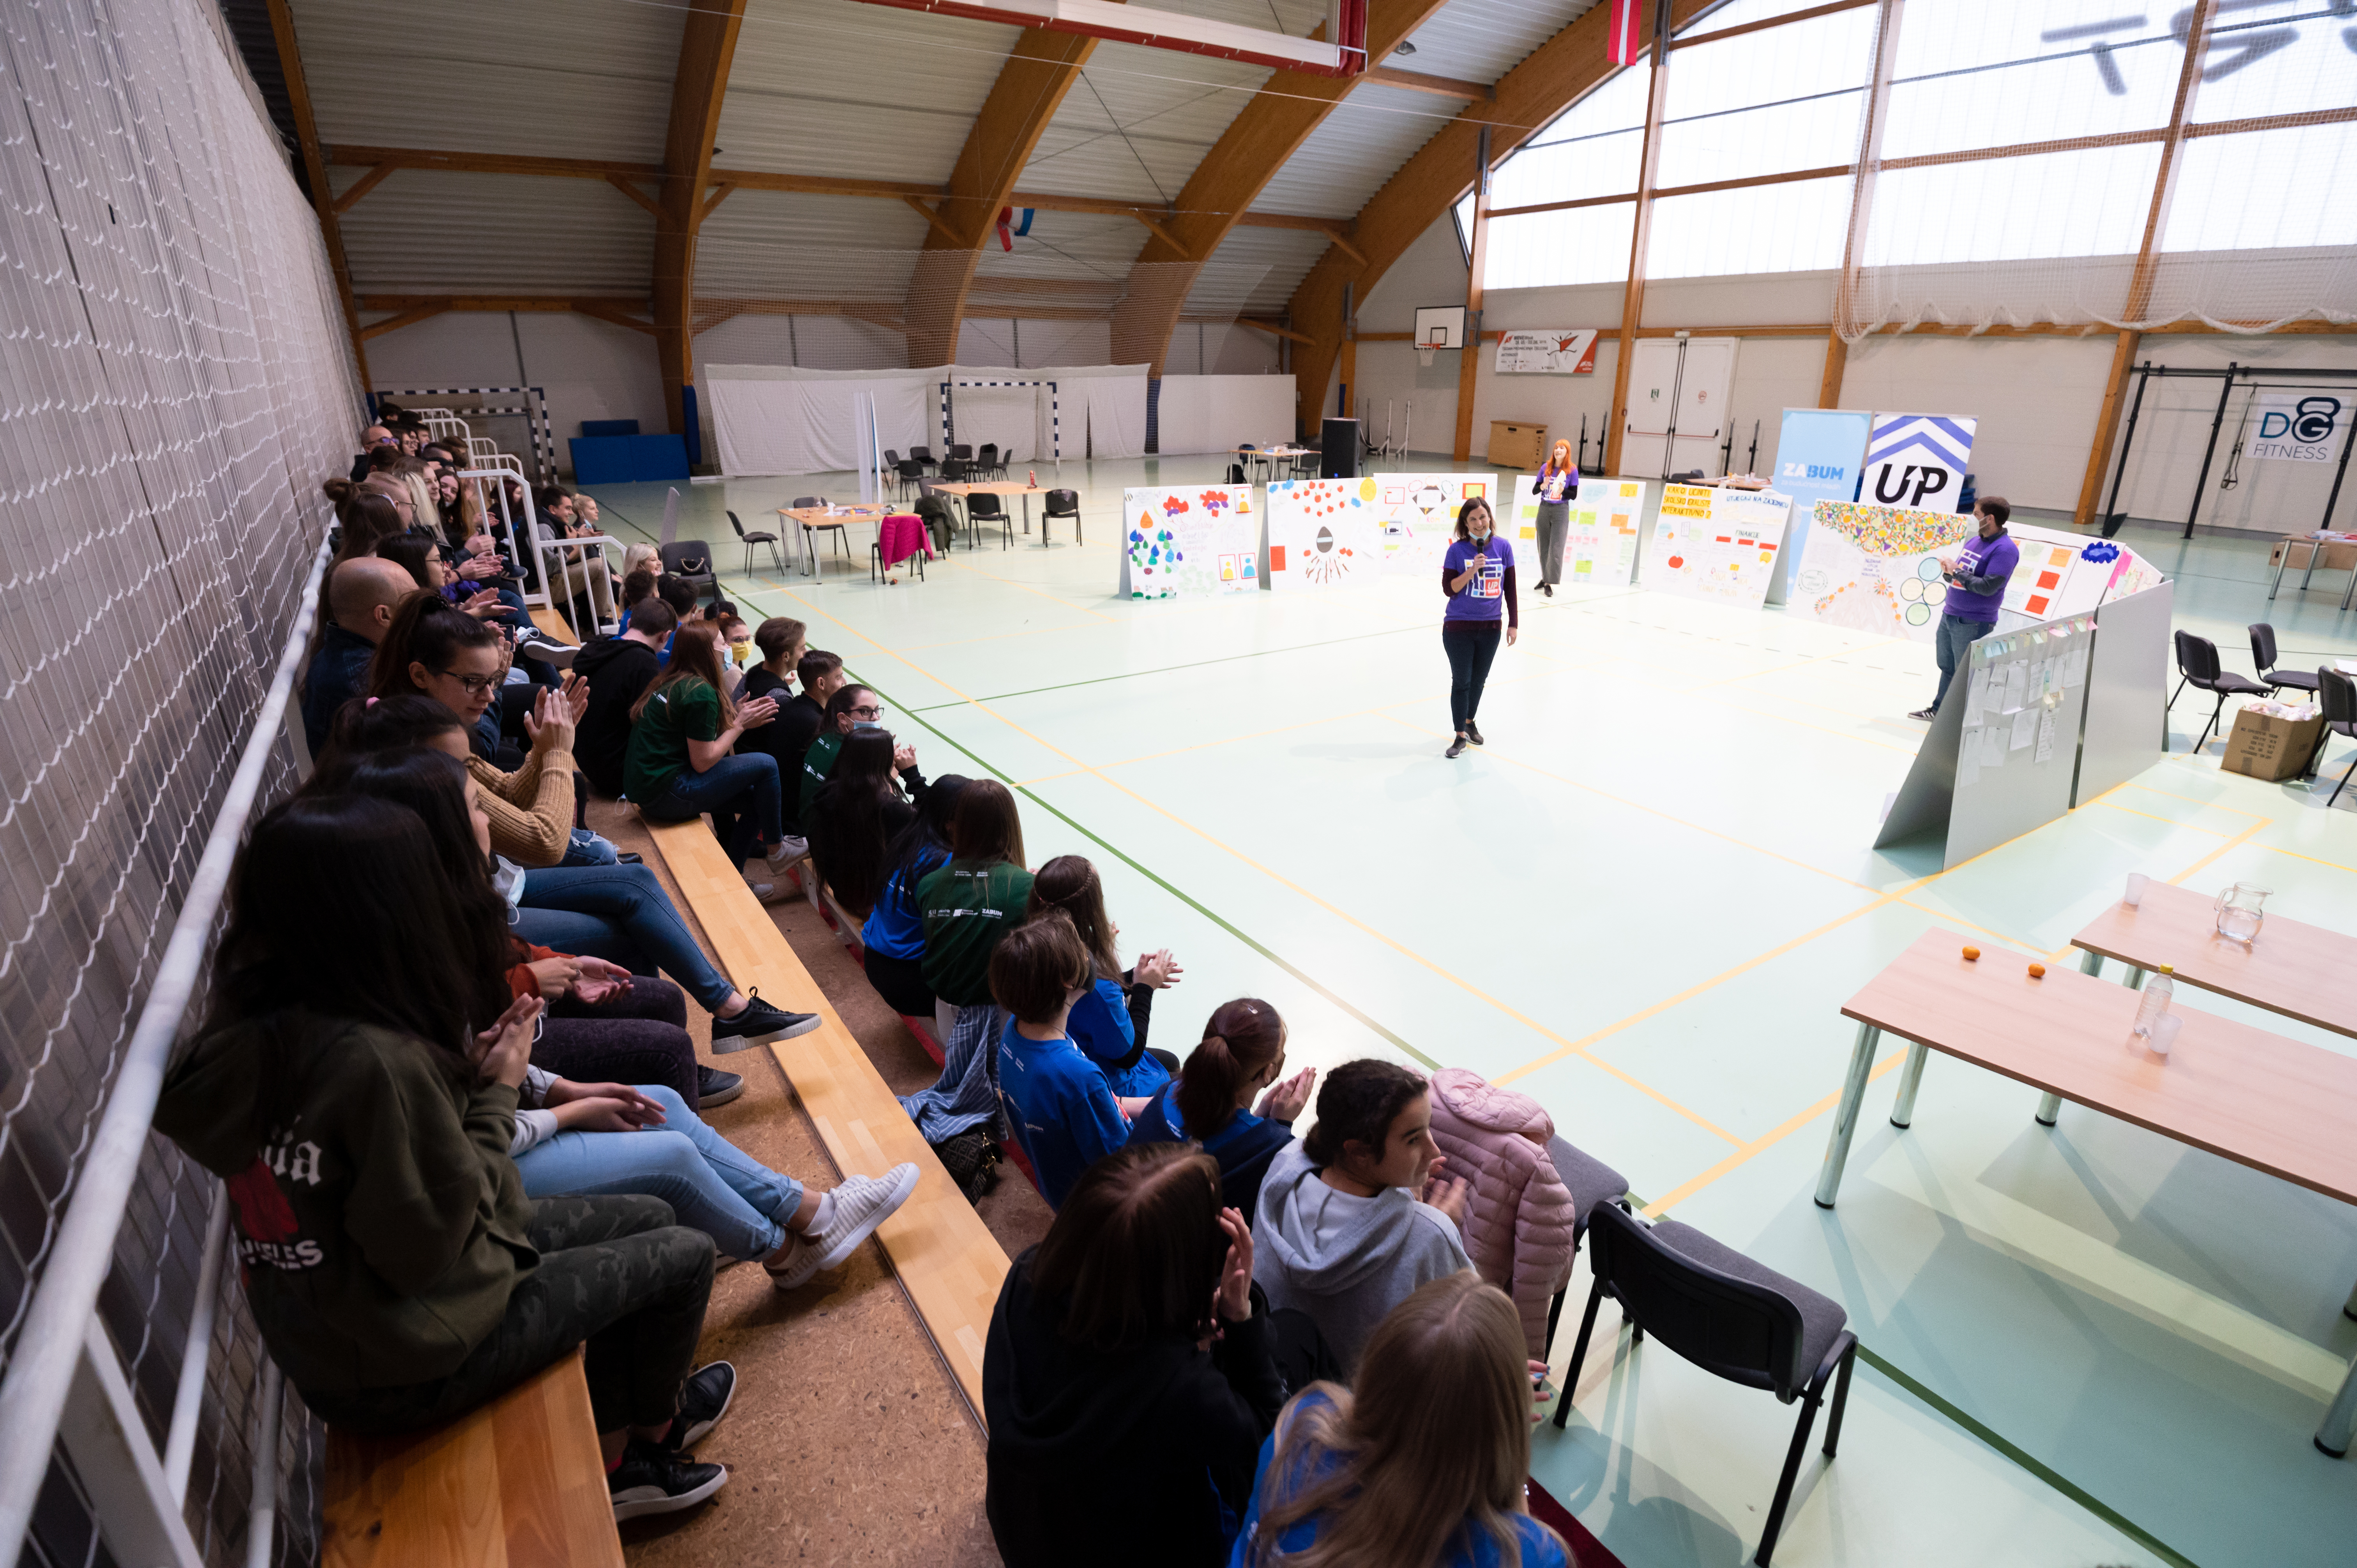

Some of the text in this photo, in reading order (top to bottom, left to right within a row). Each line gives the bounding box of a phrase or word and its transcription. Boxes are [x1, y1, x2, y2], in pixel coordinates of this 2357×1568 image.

[2254, 443, 2328, 460] FITNESS
[1783, 462, 1844, 480] ZABUM
[1875, 463, 1948, 506] UP
[1661, 506, 1705, 517] INTERAKTIVNO
[1488, 581, 1498, 590] UP
[982, 908, 1002, 916] ZABUM
